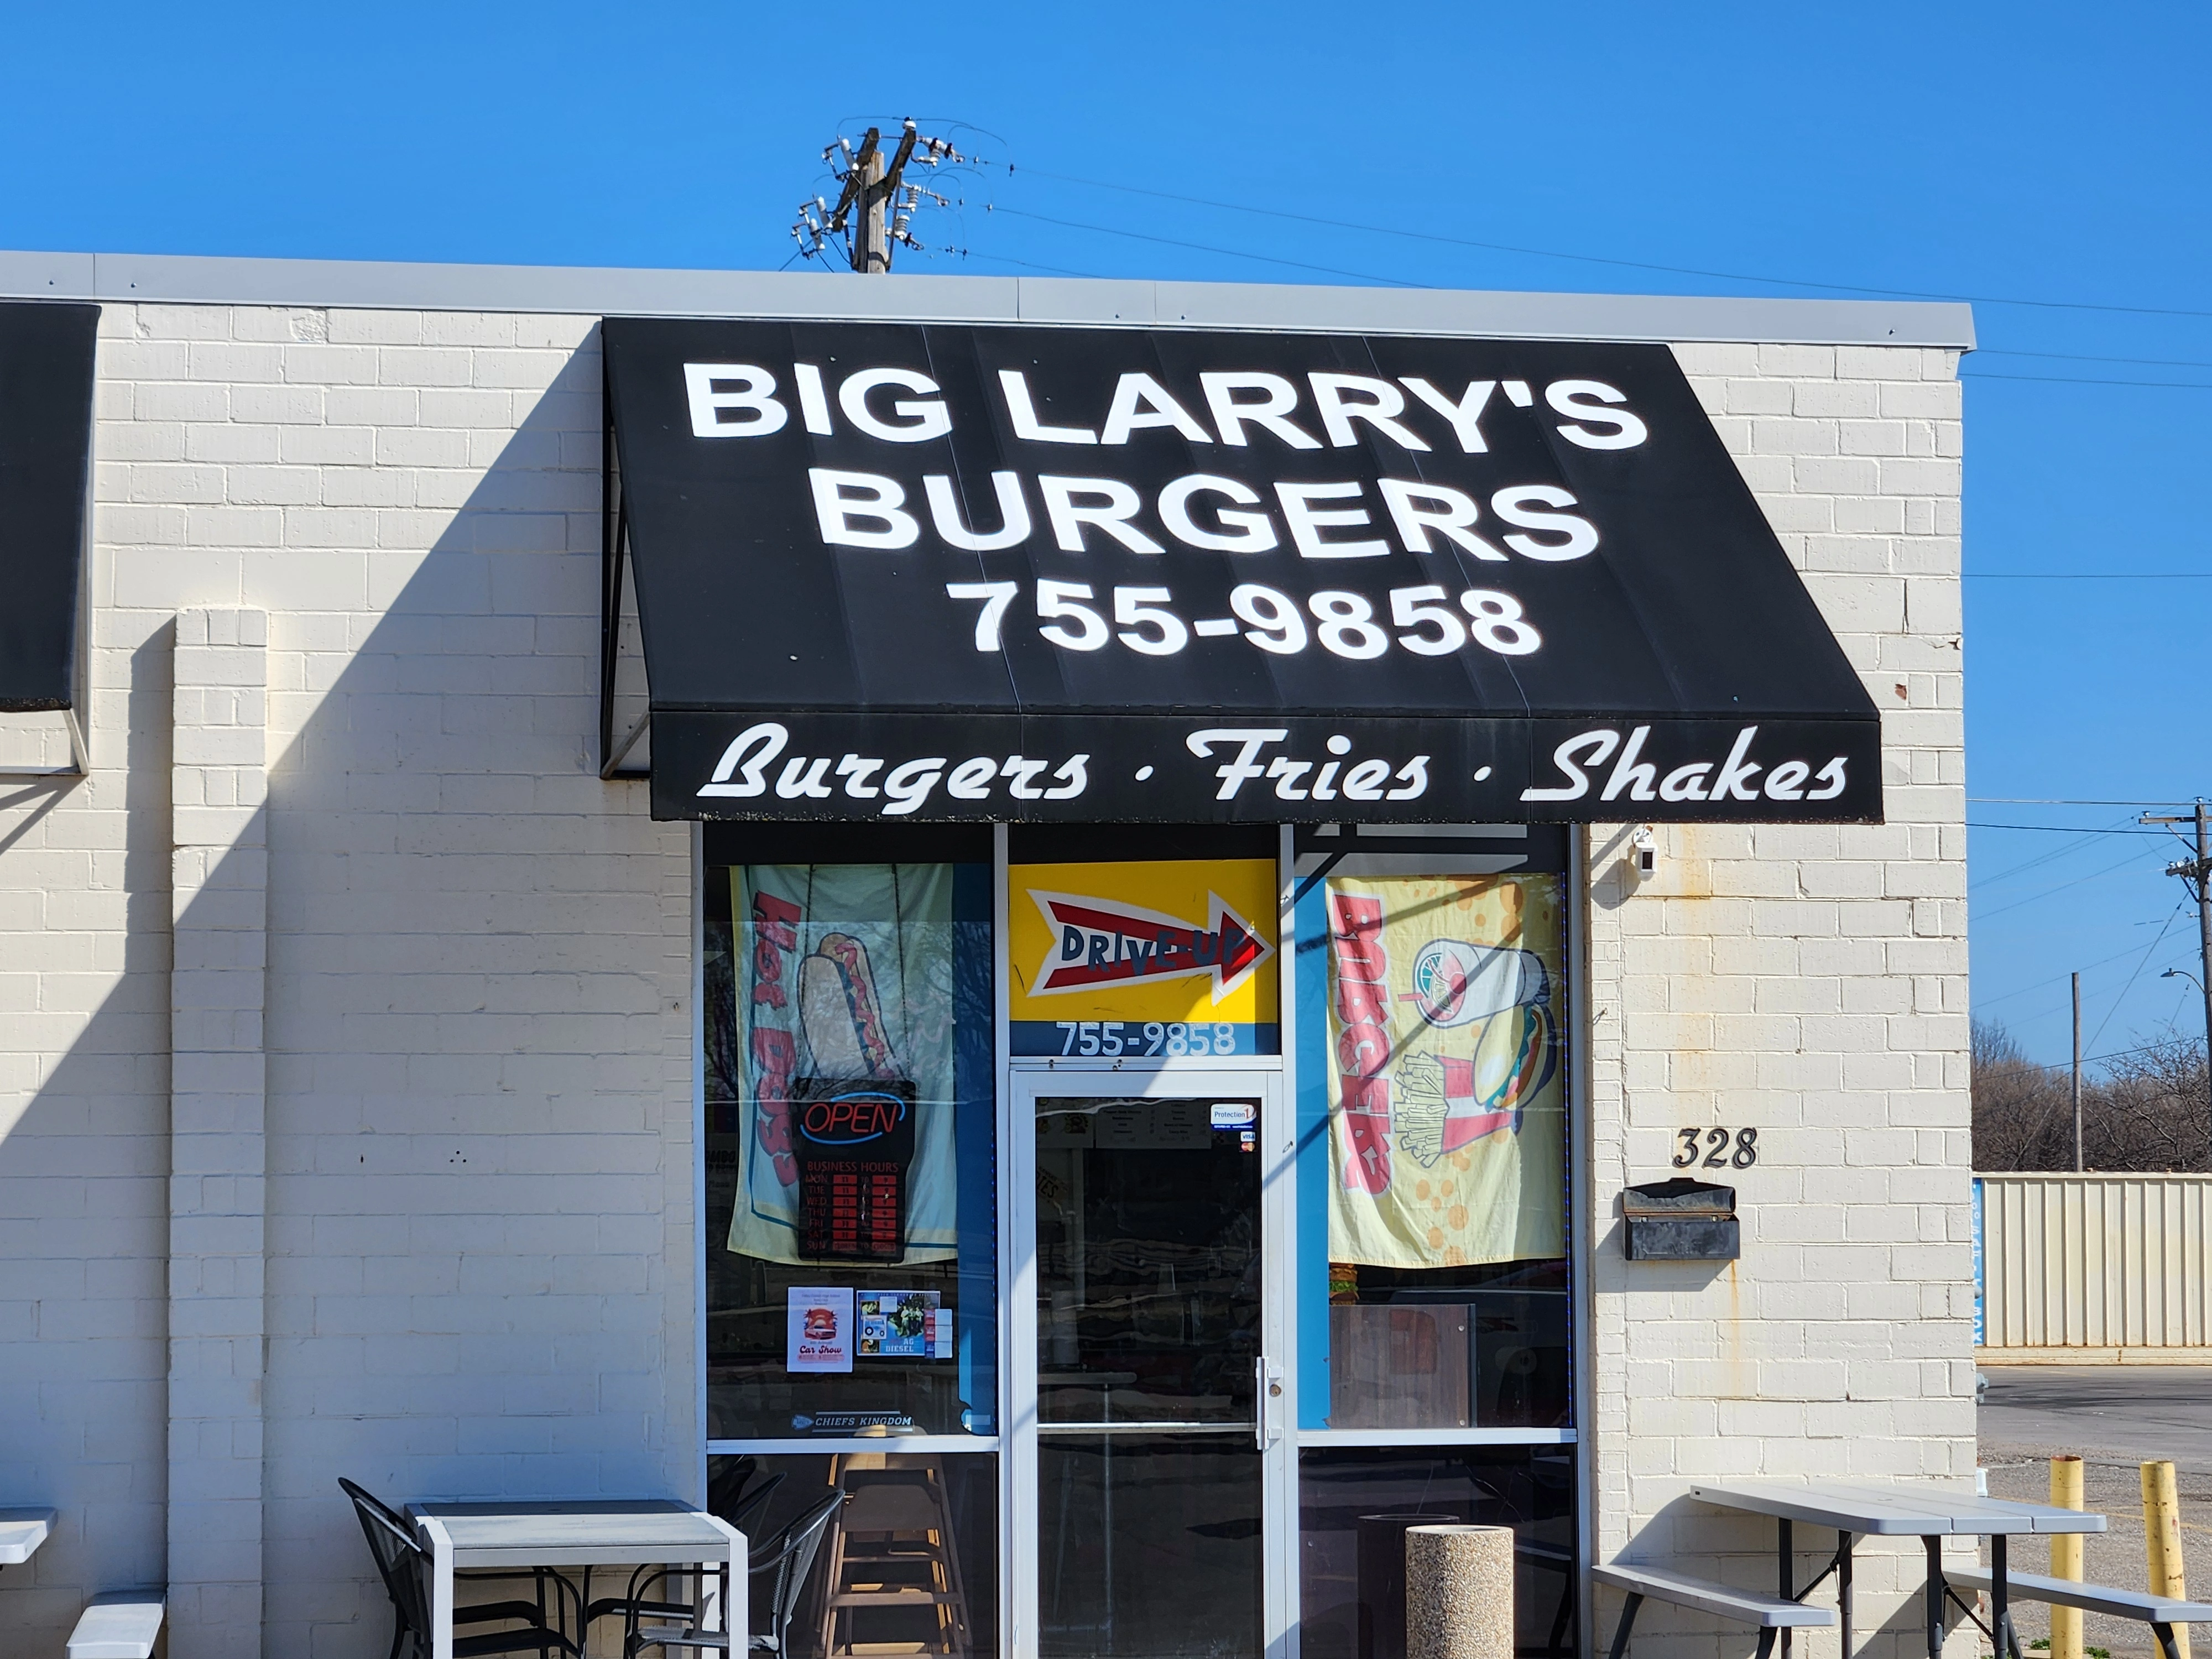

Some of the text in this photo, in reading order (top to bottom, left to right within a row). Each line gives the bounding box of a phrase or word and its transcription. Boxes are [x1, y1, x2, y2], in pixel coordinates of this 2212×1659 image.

[682, 363, 1647, 453] BIG LARRY'S
[808, 468, 1599, 561] BURGERS
[946, 578, 1542, 660] 755-9858
[696, 723, 1848, 815] Burgers Fries Shakes
[753, 890, 801, 1010] Hot
[1061, 925, 1245, 976] DRIVE-UP
[1056, 1021, 1235, 1057] 755-9858
[805, 1103, 898, 1133] OPEN
[1672, 1127, 1757, 1170] 328
[807, 1161, 899, 1173] BUSINESS HOURS
[805, 1175, 828, 1183] MON
[808, 1186, 825, 1194] TUE
[807, 1197, 827, 1206] WED
[808, 1208, 826, 1217] THU
[807, 1230, 824, 1239] SAT
[807, 1241, 826, 1250] SUN
[800, 1345, 842, 1354] Car Show
[815, 1416, 912, 1426] CHIEFS KINGDOM
